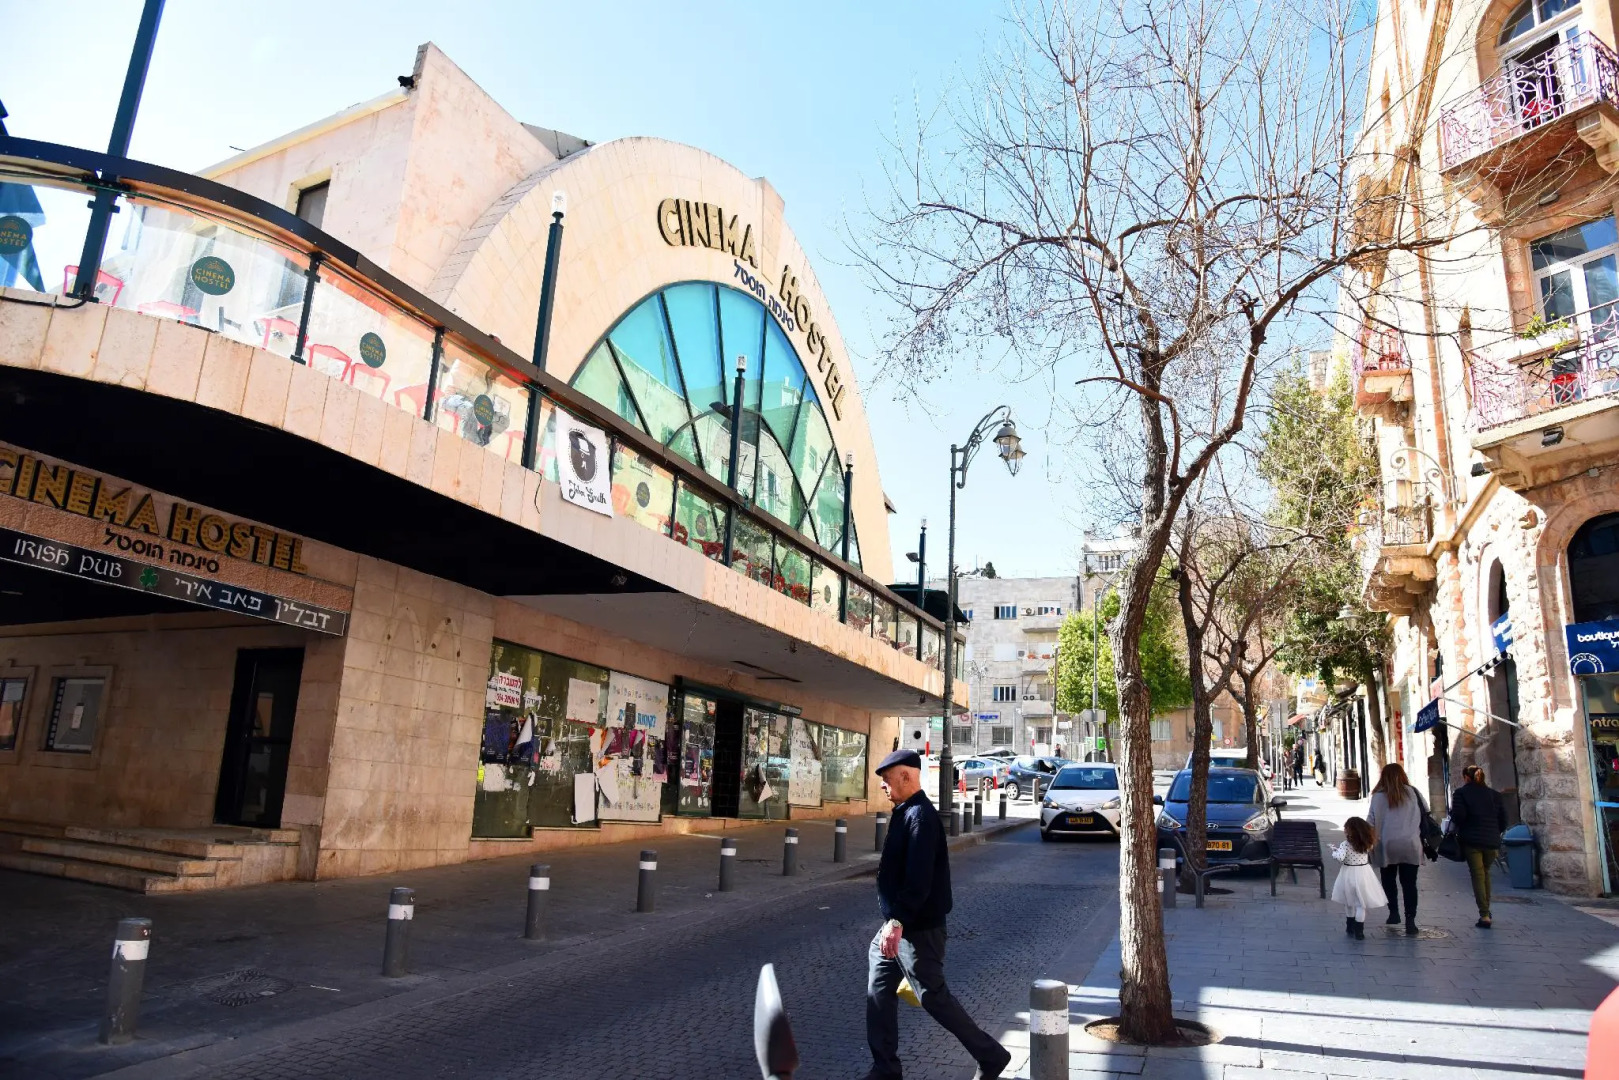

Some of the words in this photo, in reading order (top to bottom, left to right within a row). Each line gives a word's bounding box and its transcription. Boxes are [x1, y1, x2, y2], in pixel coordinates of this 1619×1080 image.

[195, 268, 231, 284] CINEMA
[195, 274, 229, 290] HOSTEL
[733, 258, 766, 300] הוסטל
[657, 198, 758, 269] CINEMA
[779, 264, 845, 421] HOSTEL
[768, 294, 795, 332] סינמה
[568, 480, 585, 500] John
[0, 447, 160, 536] CINEMA
[166, 502, 308, 575] HOSTEL
[103, 527, 164, 560] הוסטל
[79, 554, 122, 578] PUB
[169, 550, 220, 574] סינמה
[174, 577, 213, 600] אירי
[219, 589, 262, 611] פאב
[274, 598, 331, 630] דבלין
[1395, 710, 1404, 761] HOTEL
